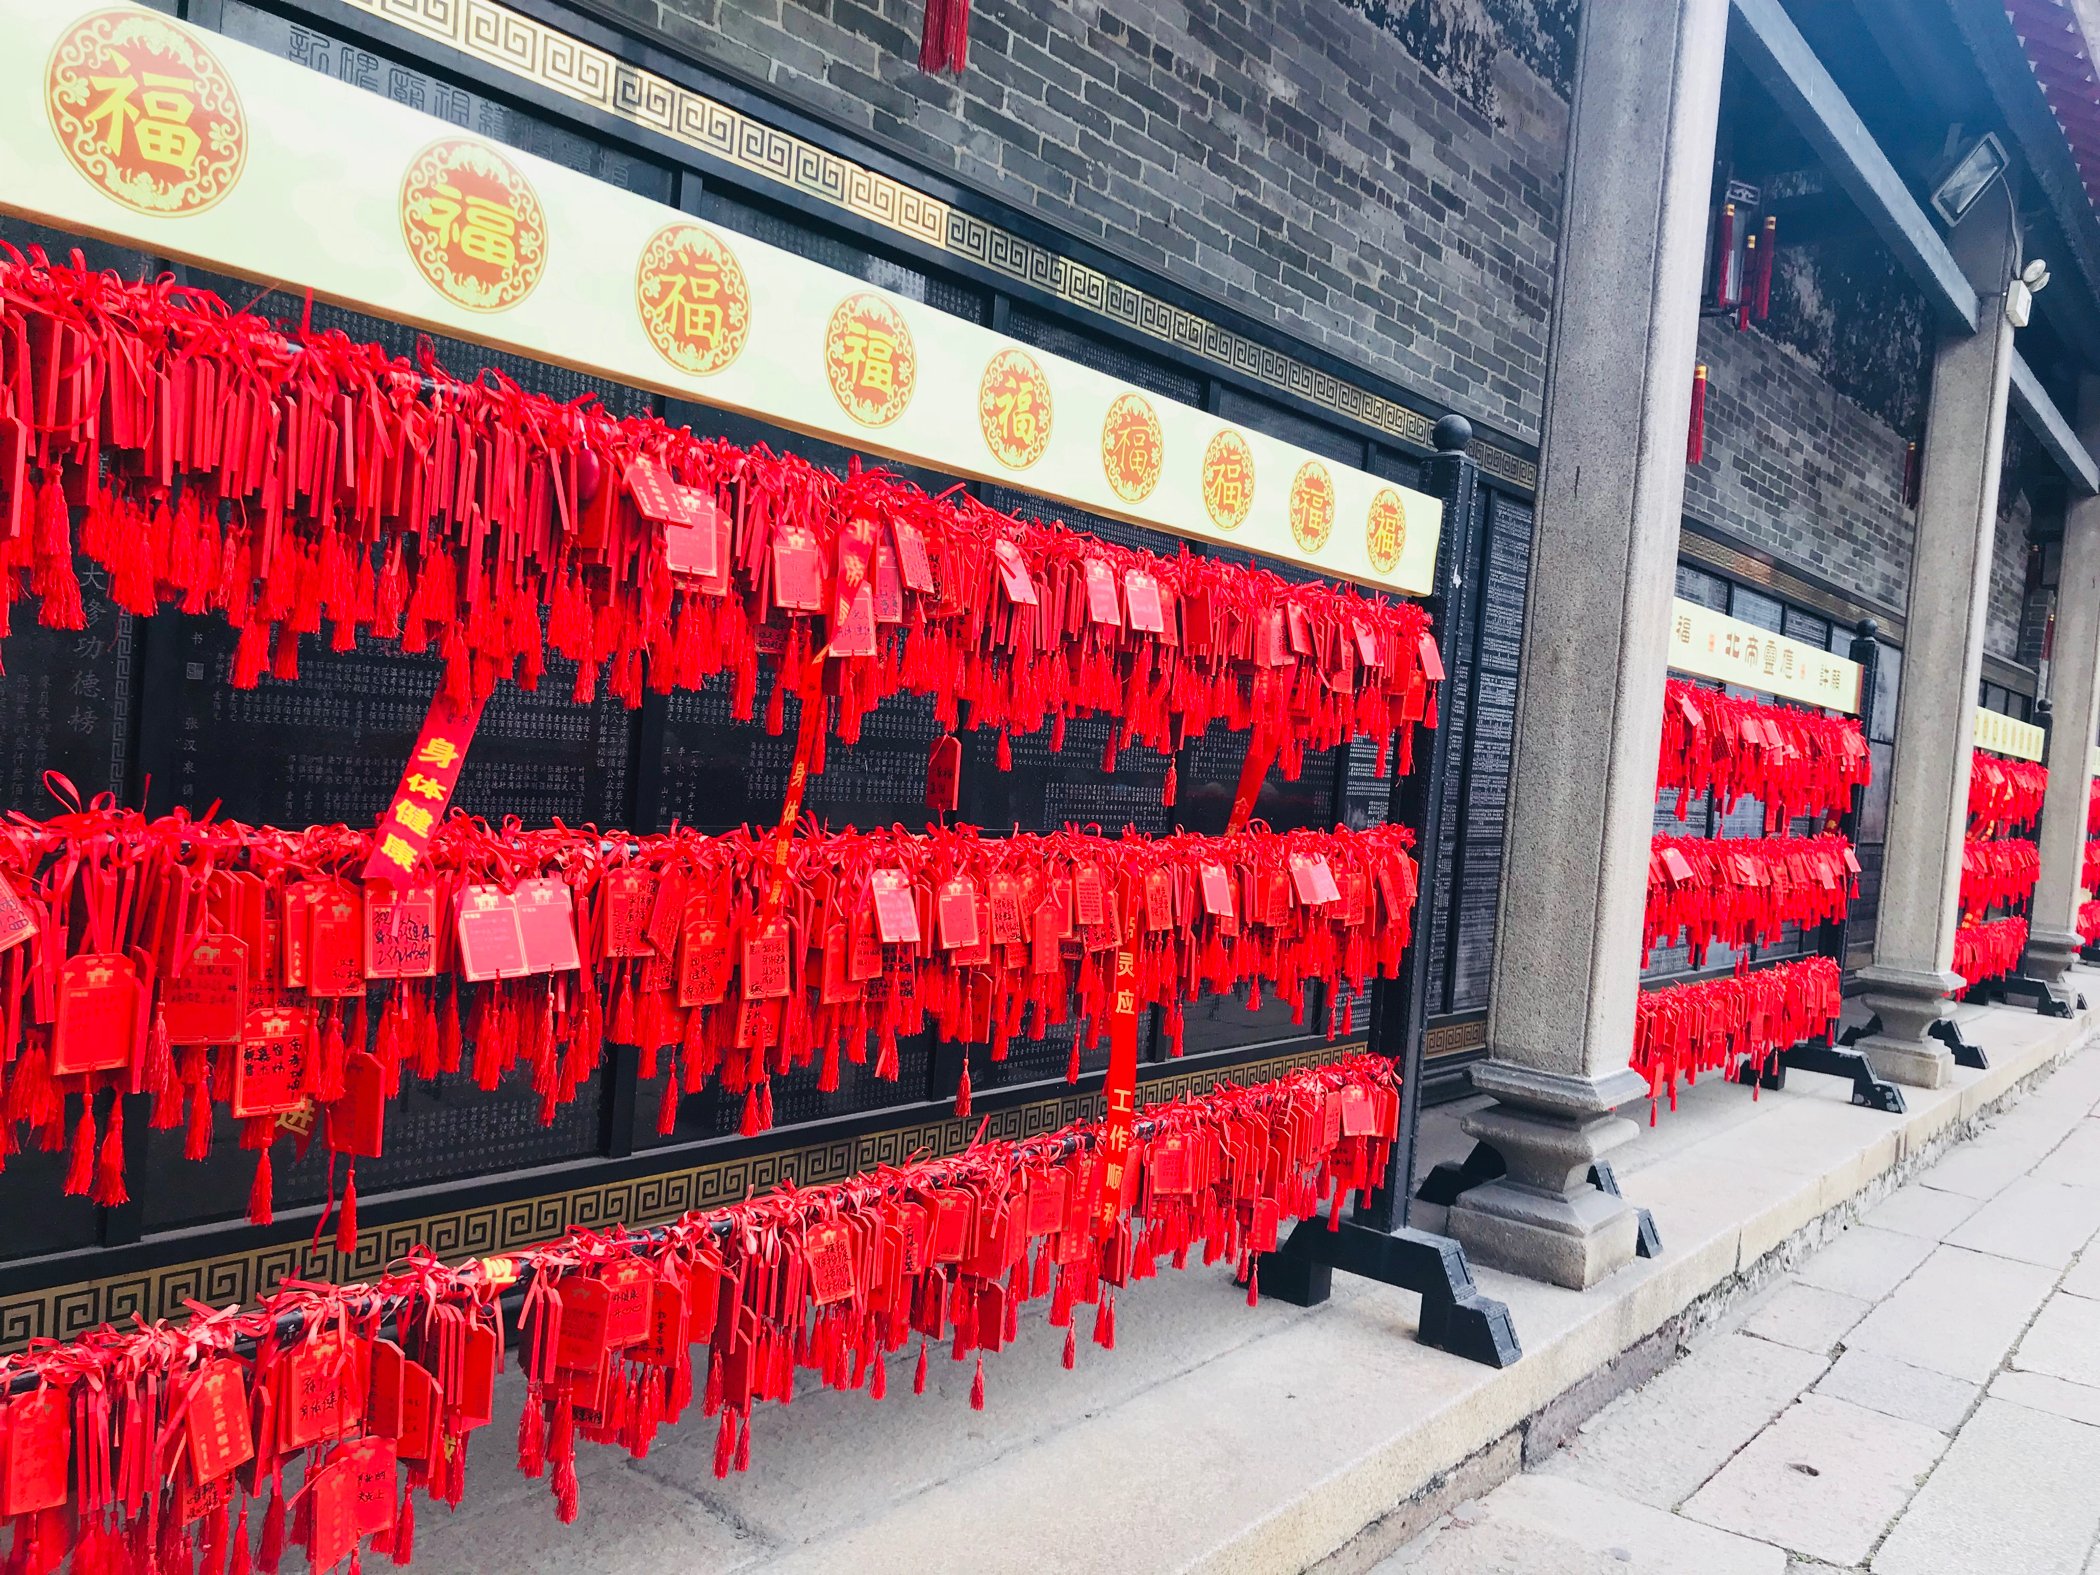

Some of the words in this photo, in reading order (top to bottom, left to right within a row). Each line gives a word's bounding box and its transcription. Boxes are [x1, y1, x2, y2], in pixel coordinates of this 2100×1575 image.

[87, 51, 205, 173] 福
[422, 183, 520, 270] 福
[657, 249, 725, 349] 福
[843, 323, 898, 396] 福
[994, 376, 1037, 447] 福
[1114, 414, 1151, 478] 福
[1212, 449, 1243, 512] 福
[1299, 480, 1326, 531] 福
[1373, 510, 1397, 554] 福
[379, 736, 460, 876] 身体健康
[768, 761, 807, 906] 身体健康
[1103, 1087, 1132, 1229] 工作顺利
